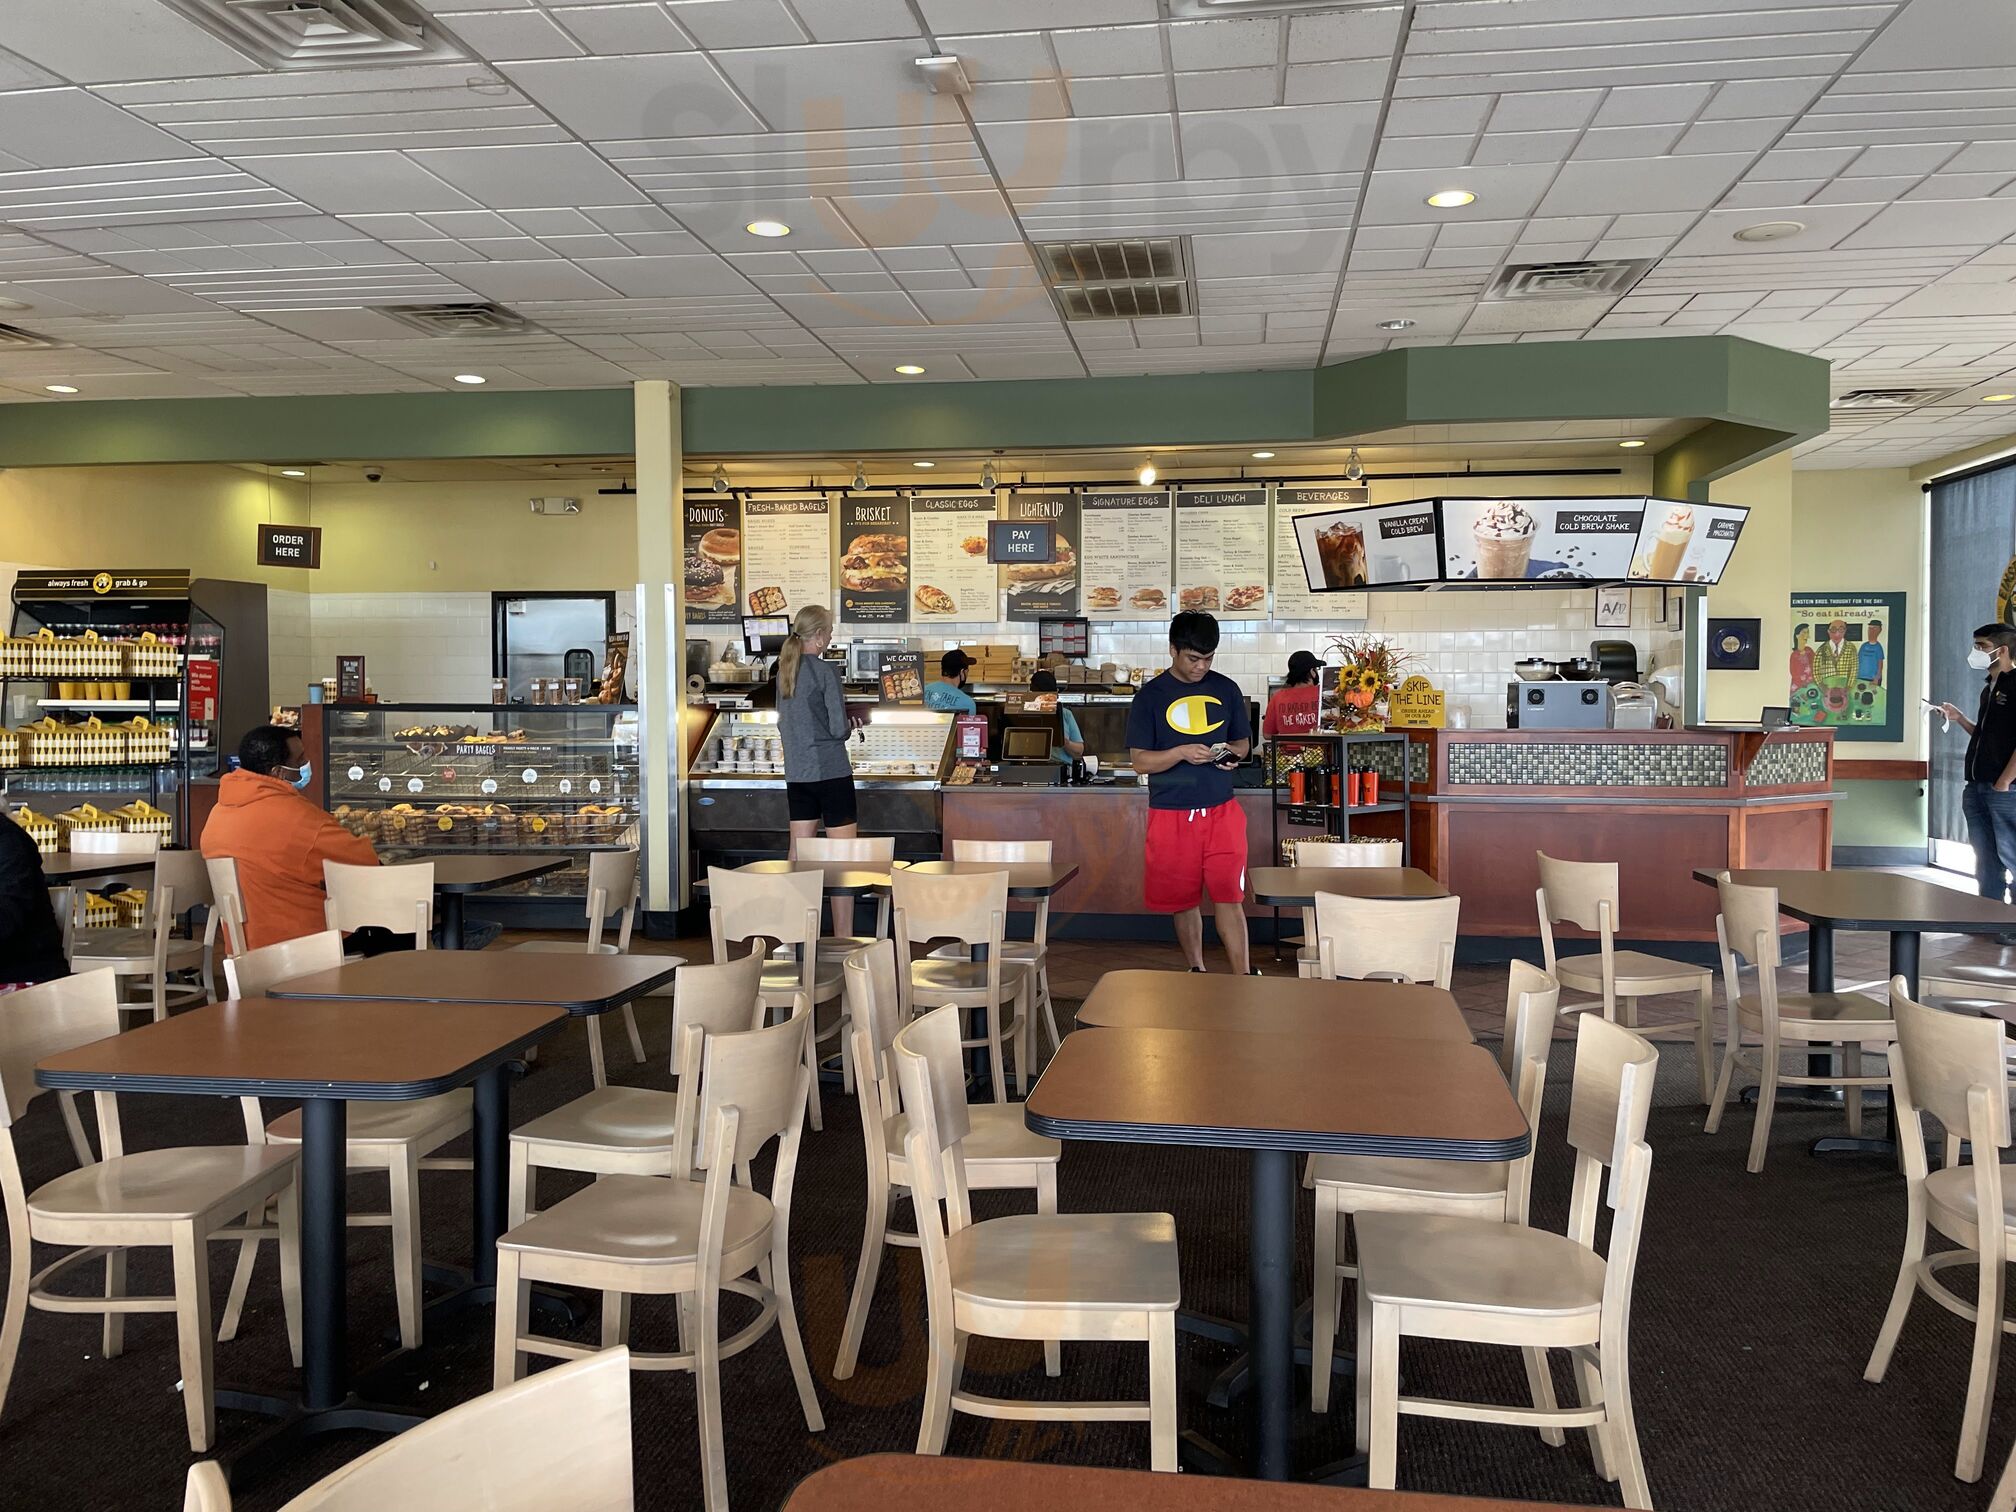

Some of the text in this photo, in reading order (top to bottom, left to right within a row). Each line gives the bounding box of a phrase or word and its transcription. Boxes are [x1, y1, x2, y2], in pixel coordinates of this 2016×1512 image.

[1193, 493, 1246, 504] DELI LUNCH
[1296, 491, 1350, 501] BEVERAGES
[925, 499, 979, 509] CLASSIC EGGS
[1092, 496, 1159, 507] SIGNATURE EGGS
[747, 502, 826, 512] FRESH-BAKED BAGELS
[1020, 501, 1064, 518] LIGHTEN UP
[689, 507, 724, 522] DONUTS
[855, 506, 891, 521] BRISKET
[1573, 514, 1617, 522] CHOCOLATE
[1383, 516, 1429, 528] VANILLA CREAM
[1559, 523, 1579, 531] COLD
[1606, 522, 1630, 530] SHAKE
[1717, 521, 1735, 530] CARAMEL
[1011, 530, 1031, 540] PAY
[1407, 526, 1424, 534] BREW
[272, 534, 304, 546] ORDER
[275, 547, 300, 558] HERE
[1007, 543, 1035, 553] HERE
[47, 579, 89, 589] always fresh
[115, 579, 131, 588] grab
[139, 580, 148, 588] go
[885, 654, 917, 663] WE CATER
[1406, 680, 1430, 692] SKIP
[1394, 693, 1442, 706] THE LINE
[1282, 712, 1317, 726] THE BAKER
[456, 744, 474, 754] PARTY
[475, 744, 496, 755] BAGELS
